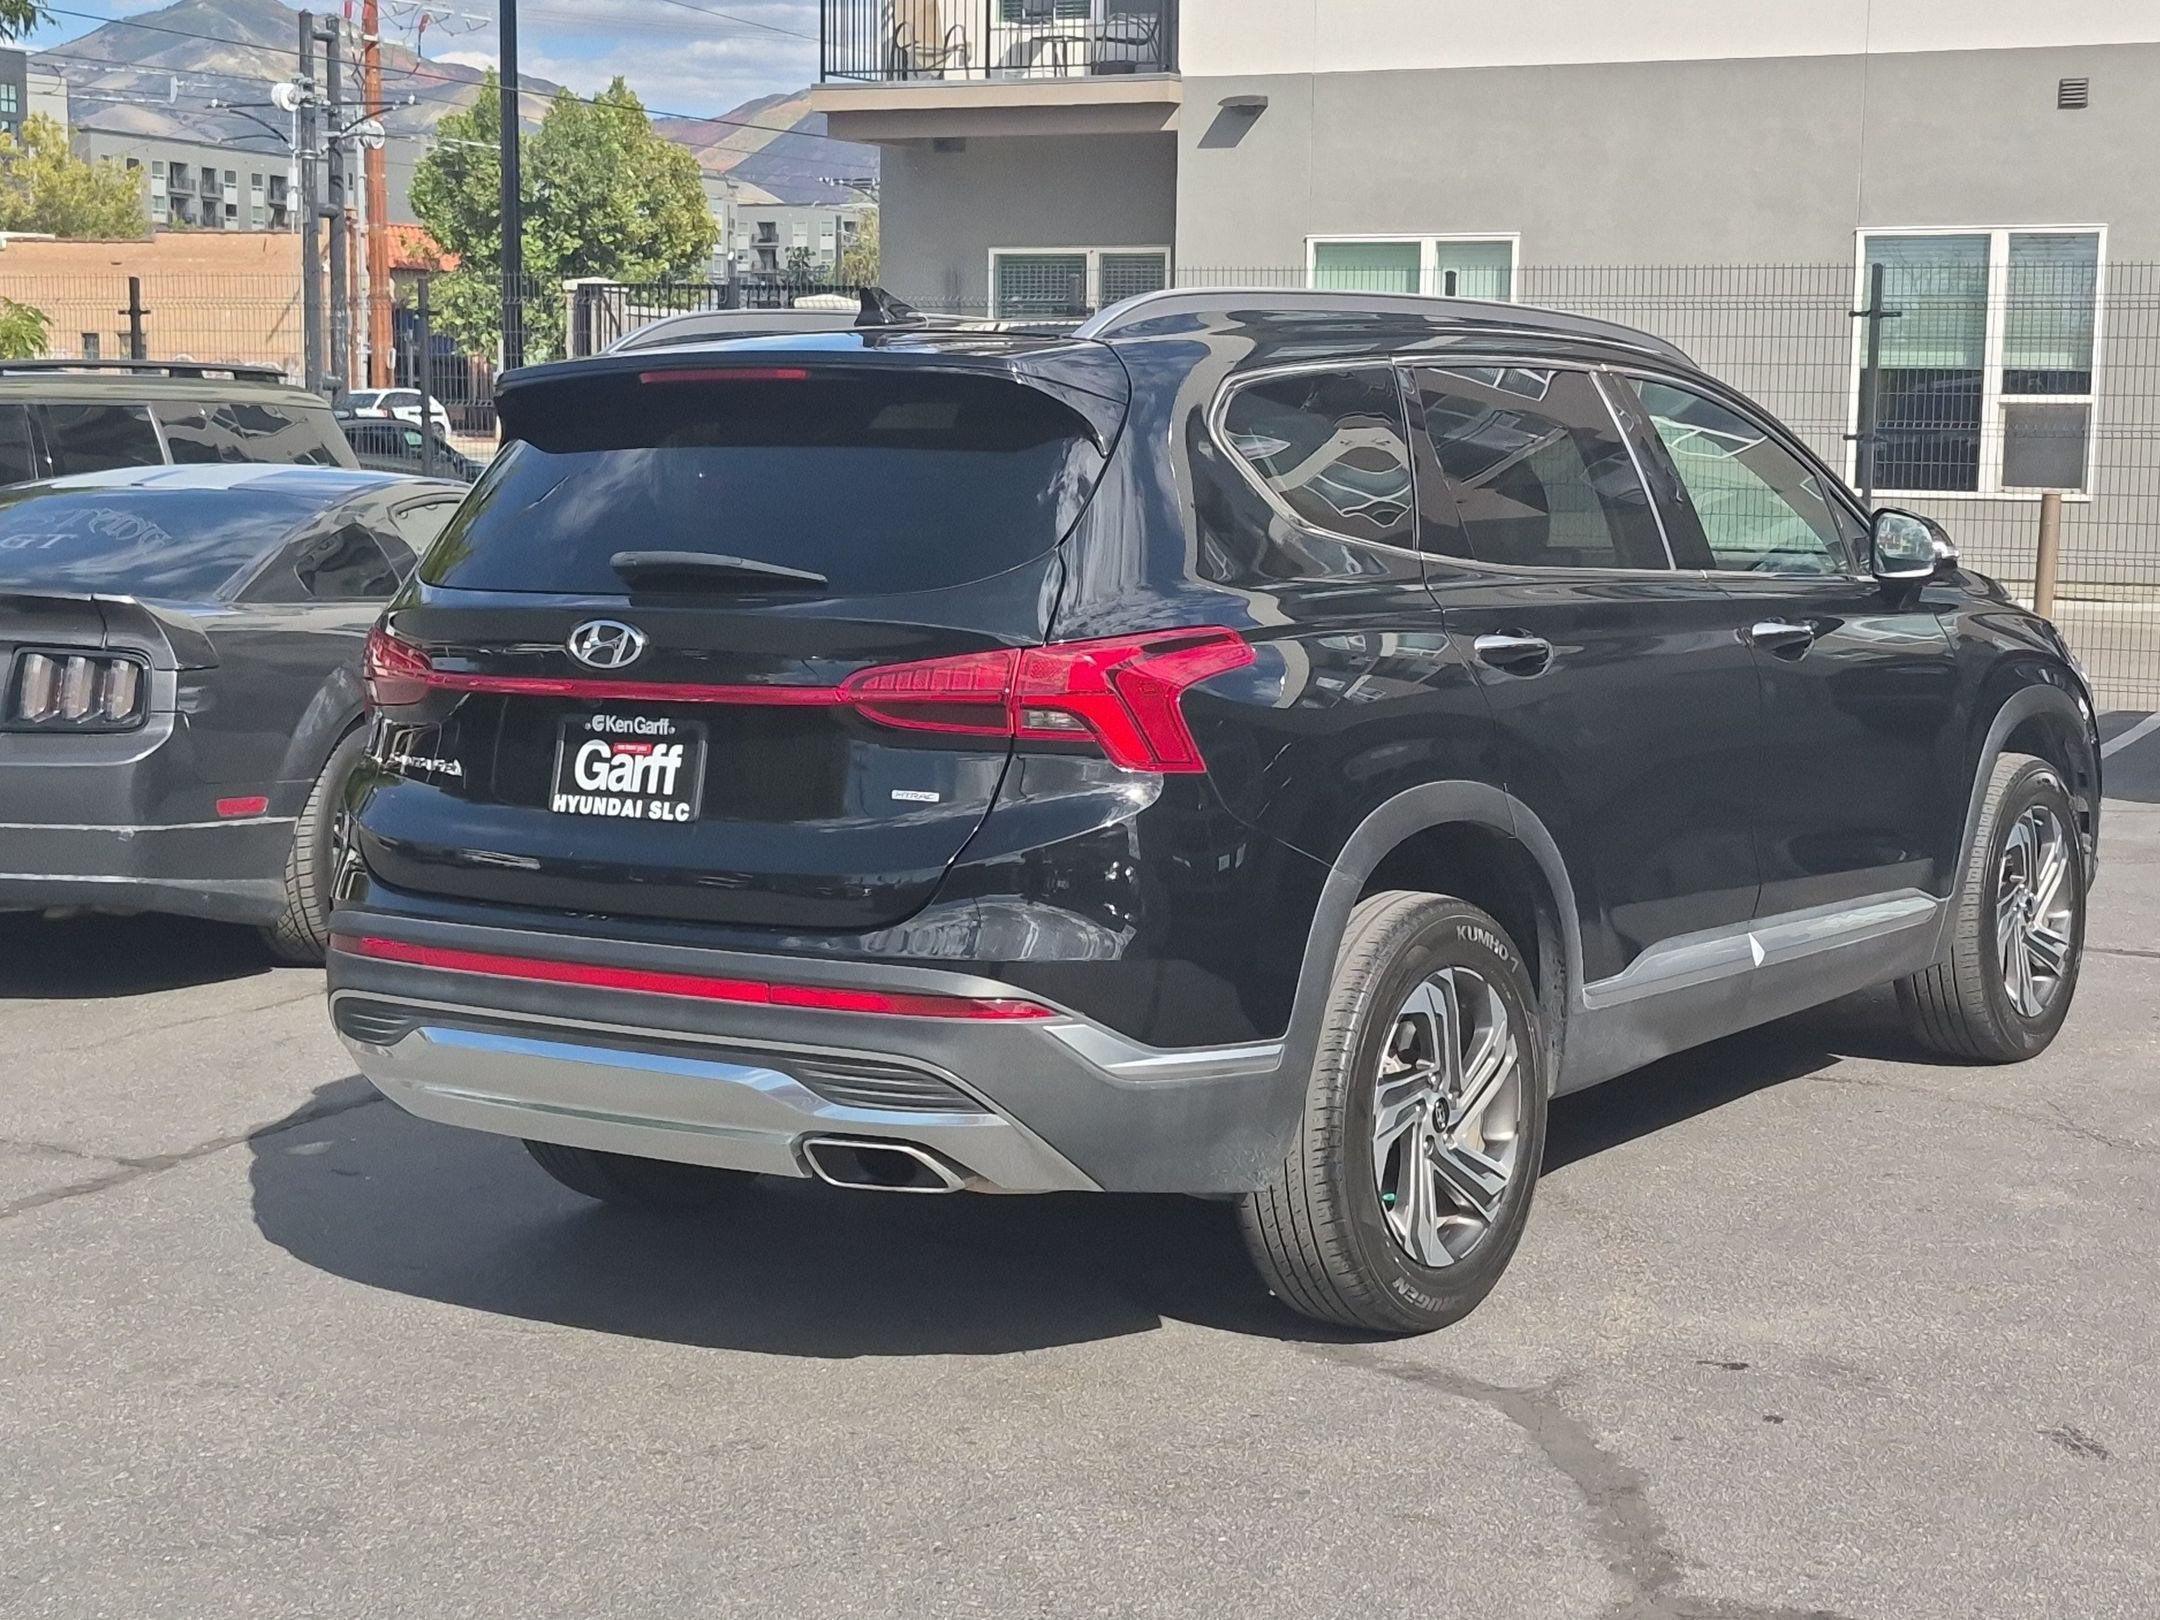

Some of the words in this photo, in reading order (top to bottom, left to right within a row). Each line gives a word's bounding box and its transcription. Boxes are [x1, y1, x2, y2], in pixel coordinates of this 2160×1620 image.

[605, 714, 634, 734] Ken
[634, 715, 670, 736] Garff
[574, 739, 684, 795] Garff
[552, 794, 644, 818] HYUNDAI
[648, 801, 691, 822] SLC
[1456, 925, 1509, 961] KUMHO
